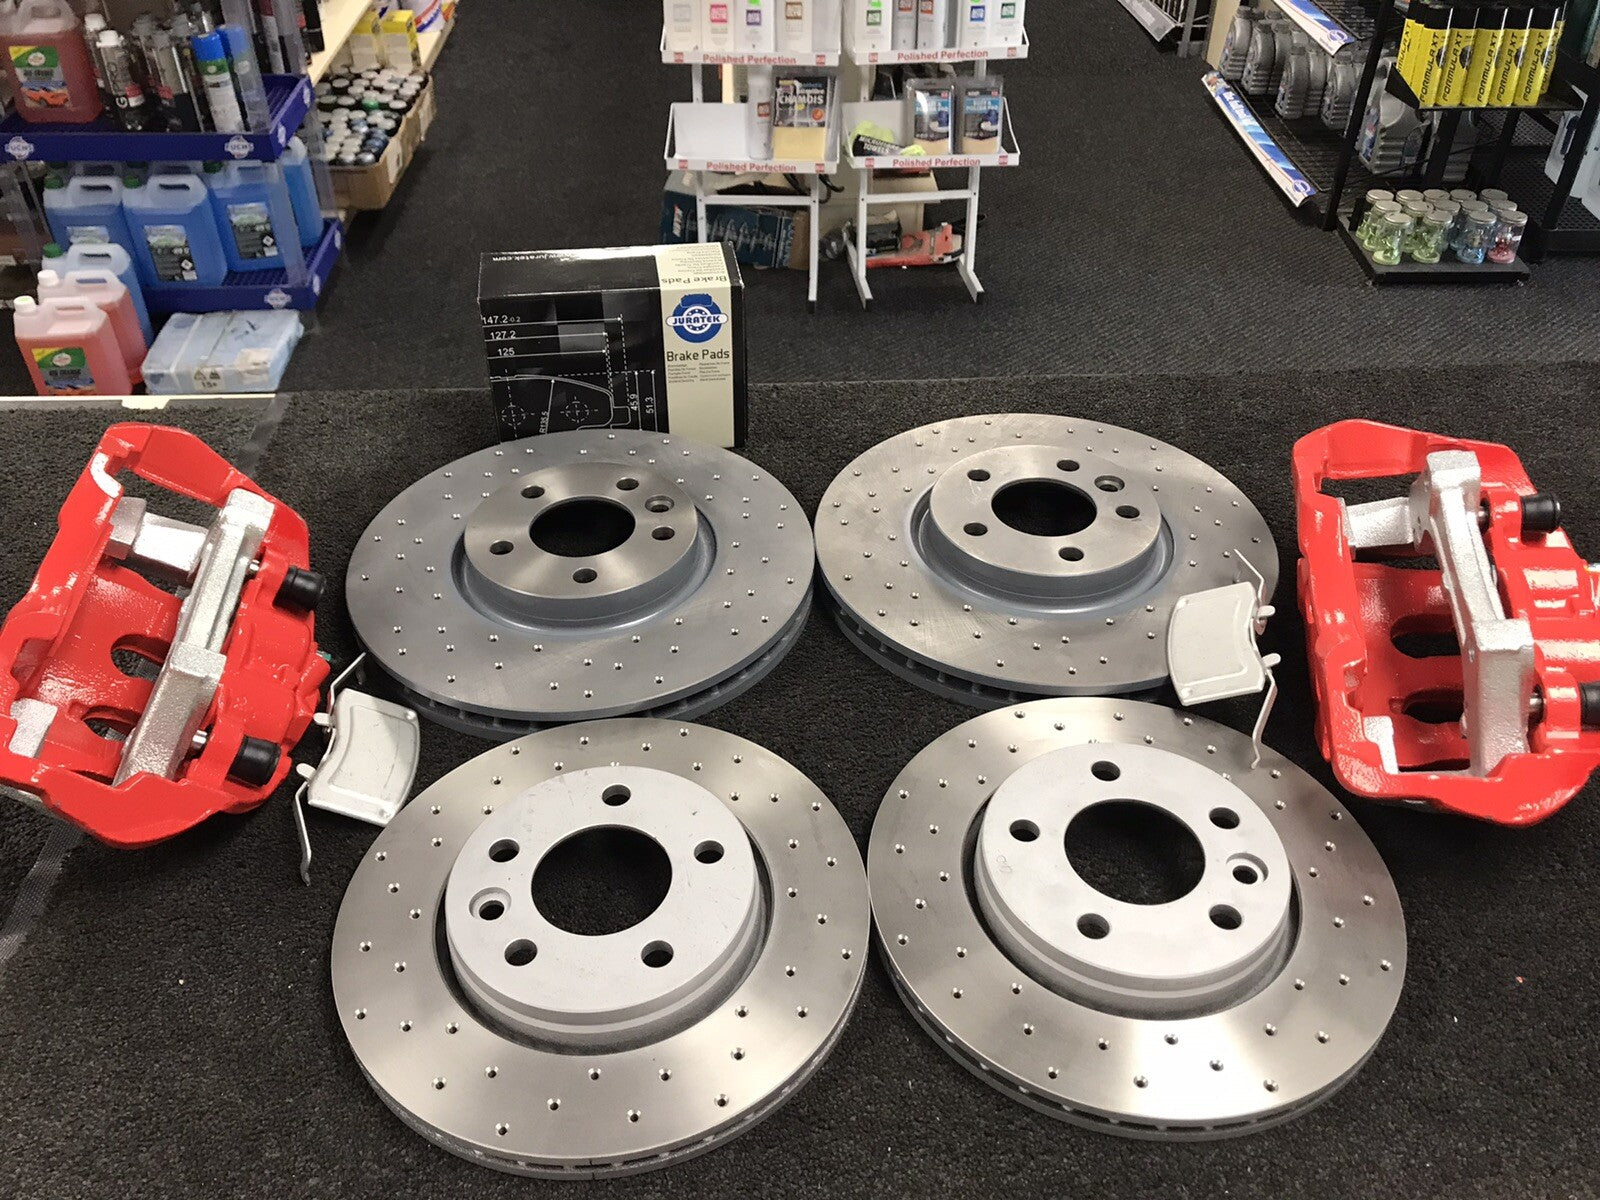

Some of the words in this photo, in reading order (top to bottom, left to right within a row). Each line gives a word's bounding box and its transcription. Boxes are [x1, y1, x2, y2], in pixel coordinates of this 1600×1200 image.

[703, 53, 744, 63] Polished
[748, 54, 797, 64] Perfection
[897, 52, 938, 61] Polished
[941, 50, 989, 60] Perfection
[1420, 49, 1435, 102] FORMULA
[1431, 32, 1440, 48] XT
[1442, 49, 1459, 102] FORMULA
[1455, 32, 1463, 46] XT
[1477, 49, 1495, 102] FORMULA
[1491, 32, 1498, 47] XT
[1496, 49, 1514, 102] FORMULA
[1509, 32, 1516, 47] XT
[1522, 49, 1540, 102] FORMULA
[1536, 32, 1544, 47] XT
[707, 162, 746, 171] Polished
[750, 163, 797, 172] Perfection
[893, 157, 932, 167] Polished
[935, 157, 981, 167] Perfection
[694, 275, 727, 283] Brake
[672, 315, 721, 325] JURATEK
[490, 330, 516, 340] 127.2
[498, 347, 515, 356] 125
[666, 350, 699, 362] Brake
[702, 348, 730, 360] Pads
[645, 396, 654, 414] 51.3
